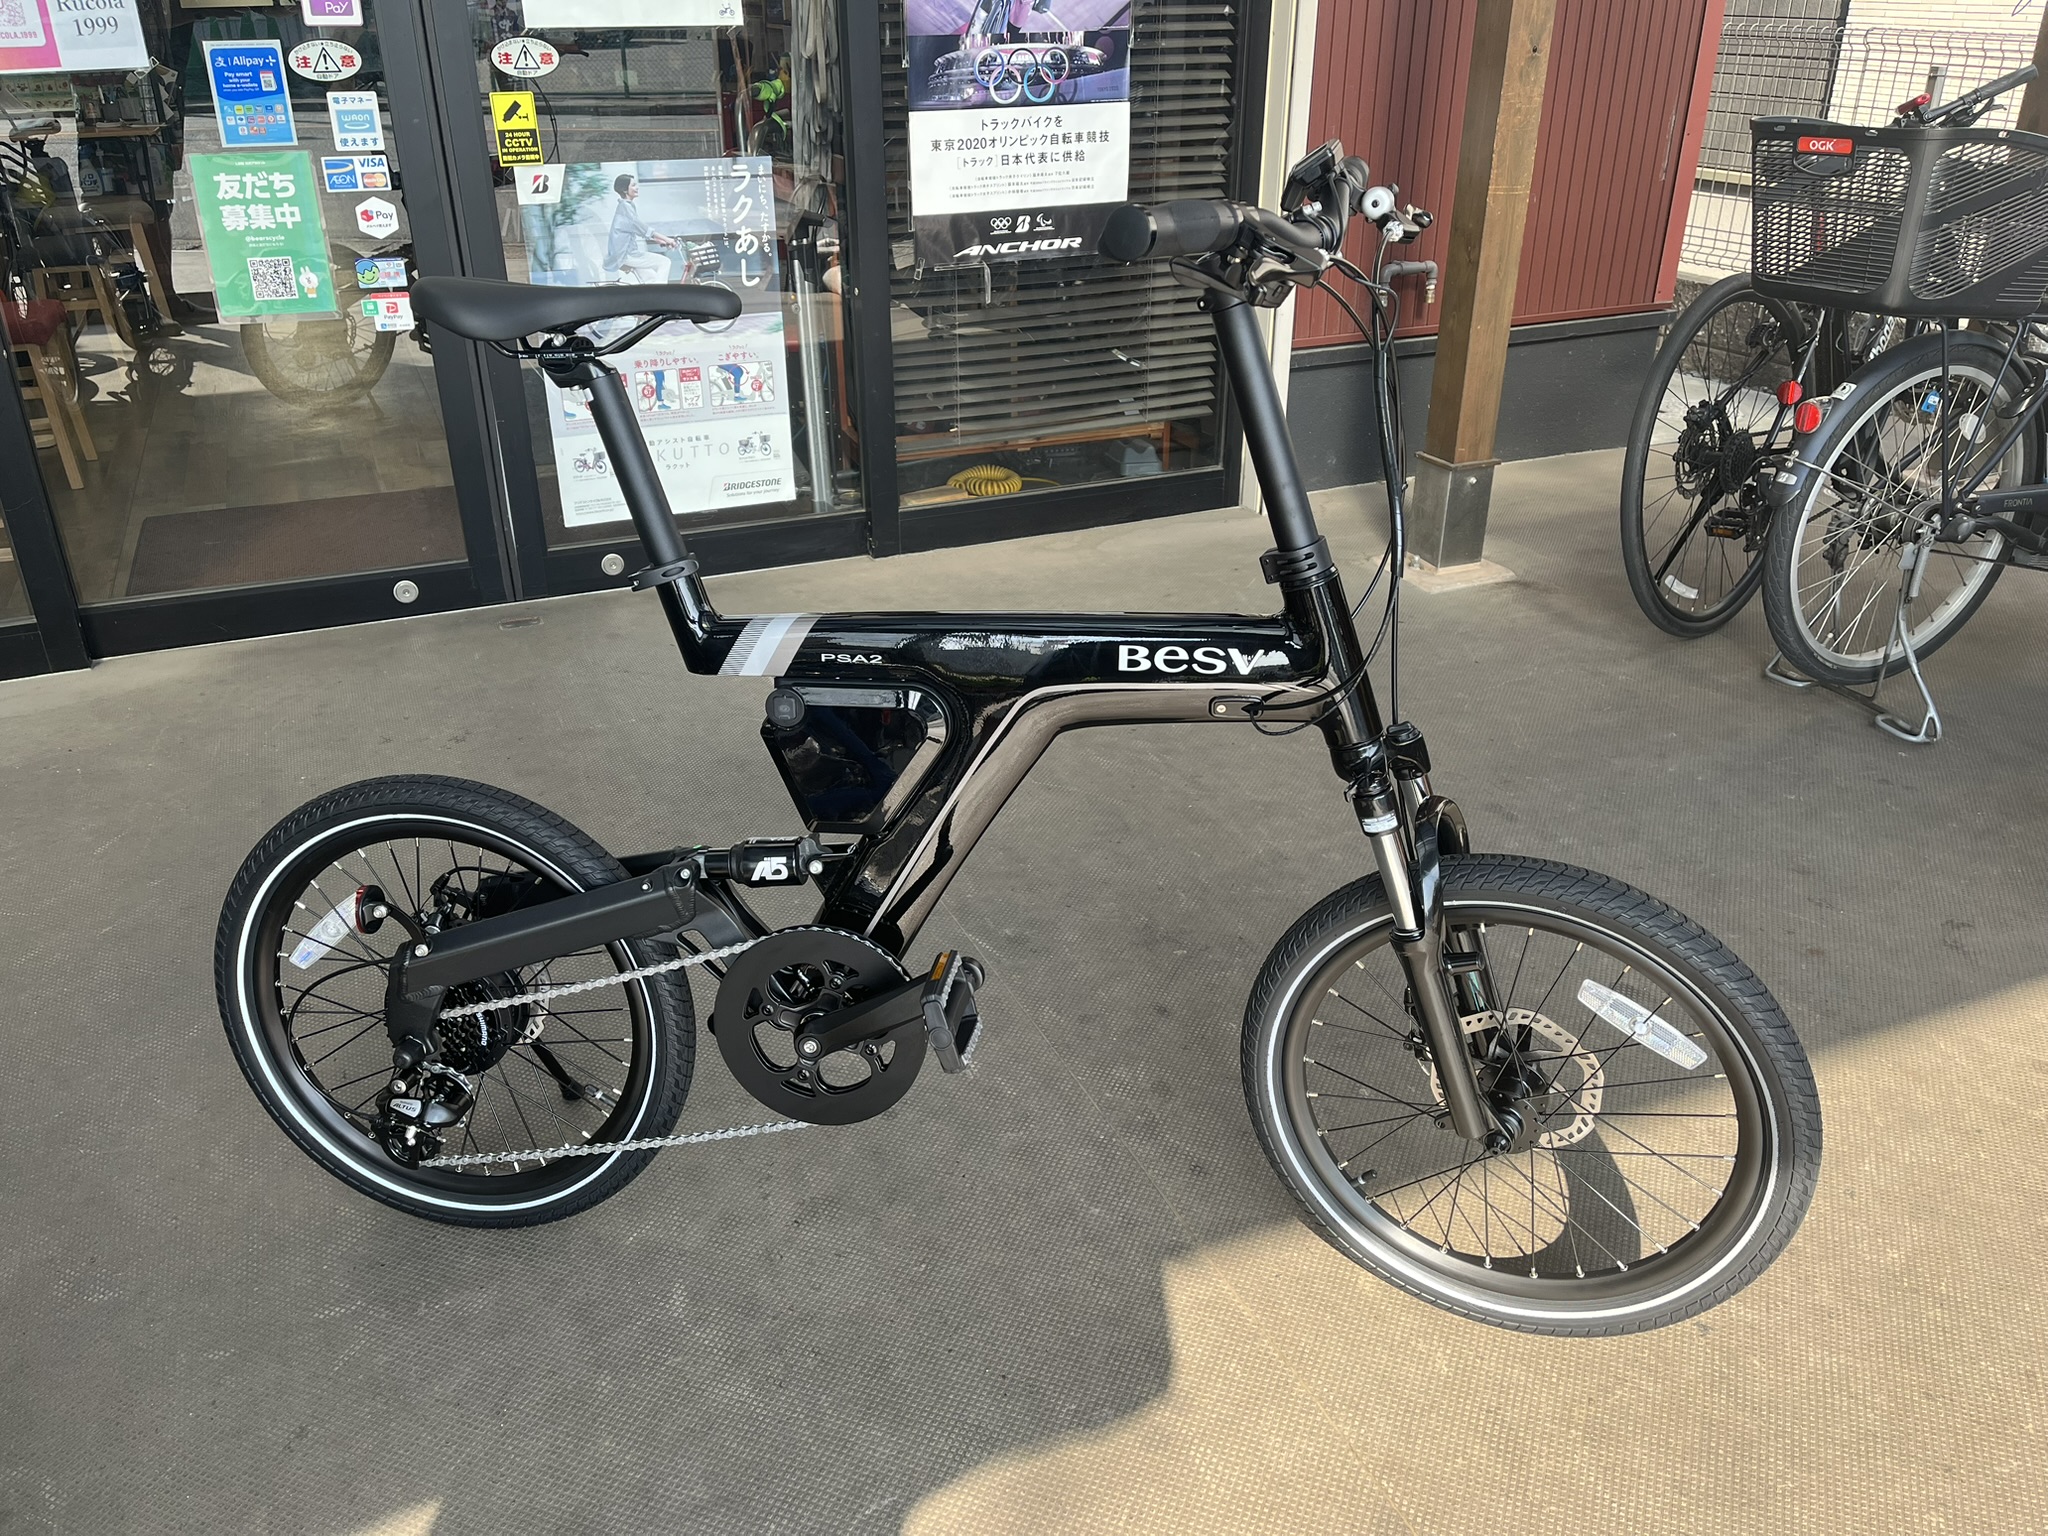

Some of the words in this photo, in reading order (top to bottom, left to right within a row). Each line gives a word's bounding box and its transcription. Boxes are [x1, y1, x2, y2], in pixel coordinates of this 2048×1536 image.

[73, 16, 118, 36] 1999
[295, 55, 312, 68] 注
[340, 55, 356, 68] 意
[498, 52, 513, 64] 注
[539, 52, 554, 64] 意
[332, 97, 373, 105] 電子マネー
[981, 115, 1063, 131] トラックバイクを
[340, 138, 379, 147] 使えます
[505, 138, 533, 147] CCTV
[931, 130, 1110, 152] 東京2020オリンピック自転車競技
[1810, 139, 1837, 151] OGK
[358, 158, 385, 168] VISA
[213, 170, 296, 200] 友だち
[375, 211, 394, 220] Pay
[757, 164, 772, 257] まいにち、たすかる。
[219, 203, 302, 231] 募集中
[730, 164, 760, 287] ラクあし
[953, 236, 1082, 257] ANCHOR
[718, 352, 759, 361] こぎやすい。
[634, 357, 699, 369] 乗り降りしやすい。
[666, 462, 690, 470] ラクット
[723, 478, 782, 491] BRIDGESTONE
[2003, 498, 2033, 508] FRONTIA
[821, 653, 882, 664] PSA2
[476, 1012, 488, 1046] SHIMANO
[393, 1103, 417, 1112] ALTUS
